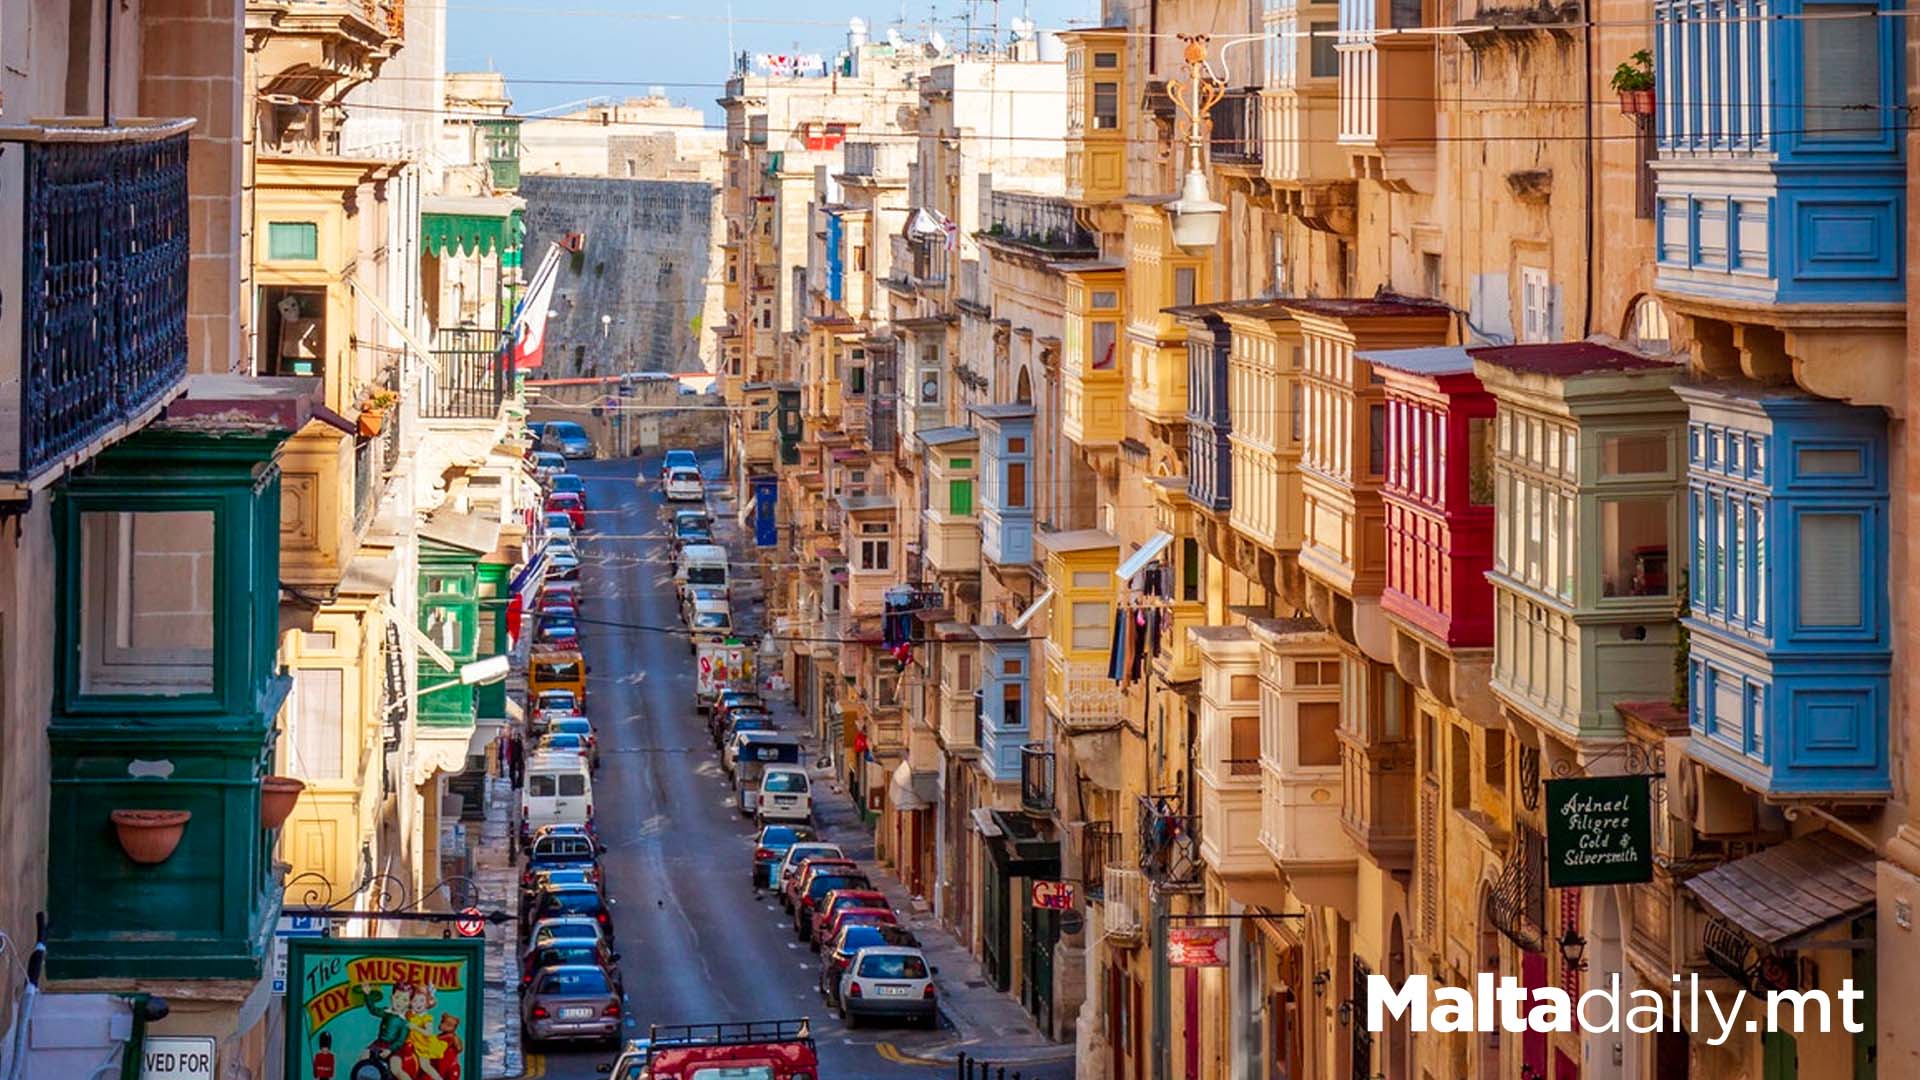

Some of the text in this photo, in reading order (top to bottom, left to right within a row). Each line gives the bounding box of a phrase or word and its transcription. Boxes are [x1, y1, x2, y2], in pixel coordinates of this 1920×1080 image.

[1560, 792, 1630, 815] Ardnael
[1569, 814, 1630, 834] Filigree
[1579, 834, 1610, 849] Gold
[1564, 847, 1639, 867] Silversmith
[306, 957, 341, 995] The
[355, 960, 459, 988] MUSEUM
[311, 987, 351, 1023] TOY
[180, 1052, 209, 1073] FOR
